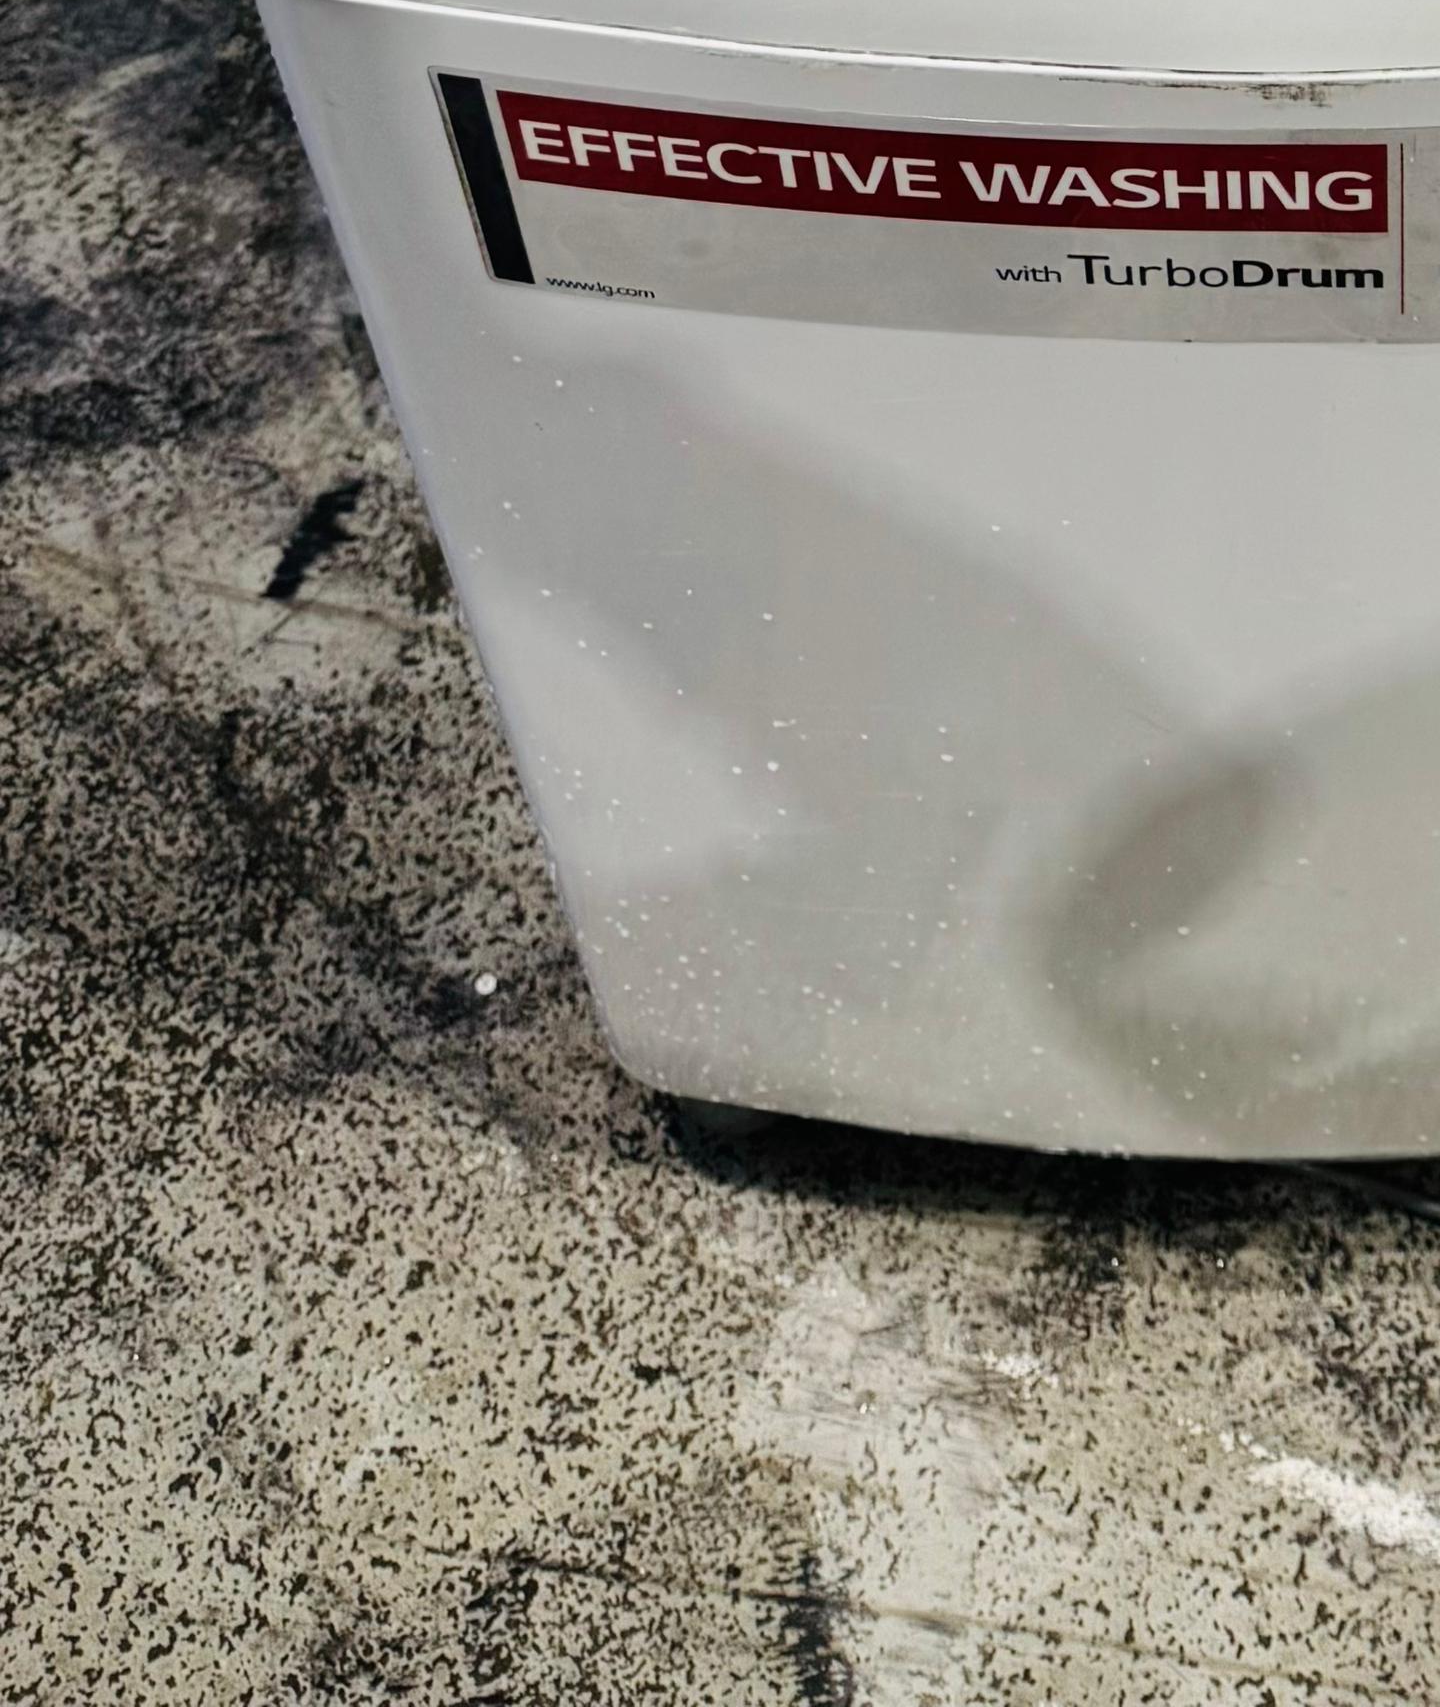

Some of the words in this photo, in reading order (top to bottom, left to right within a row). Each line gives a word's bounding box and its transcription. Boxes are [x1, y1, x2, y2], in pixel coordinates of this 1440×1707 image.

[517, 117, 942, 200] EFFECTIVE
[958, 159, 1374, 213] WASHING
[546, 277, 656, 299] www.lg.com
[995, 262, 1063, 284] with
[1066, 254, 1386, 290] TurboDrum
